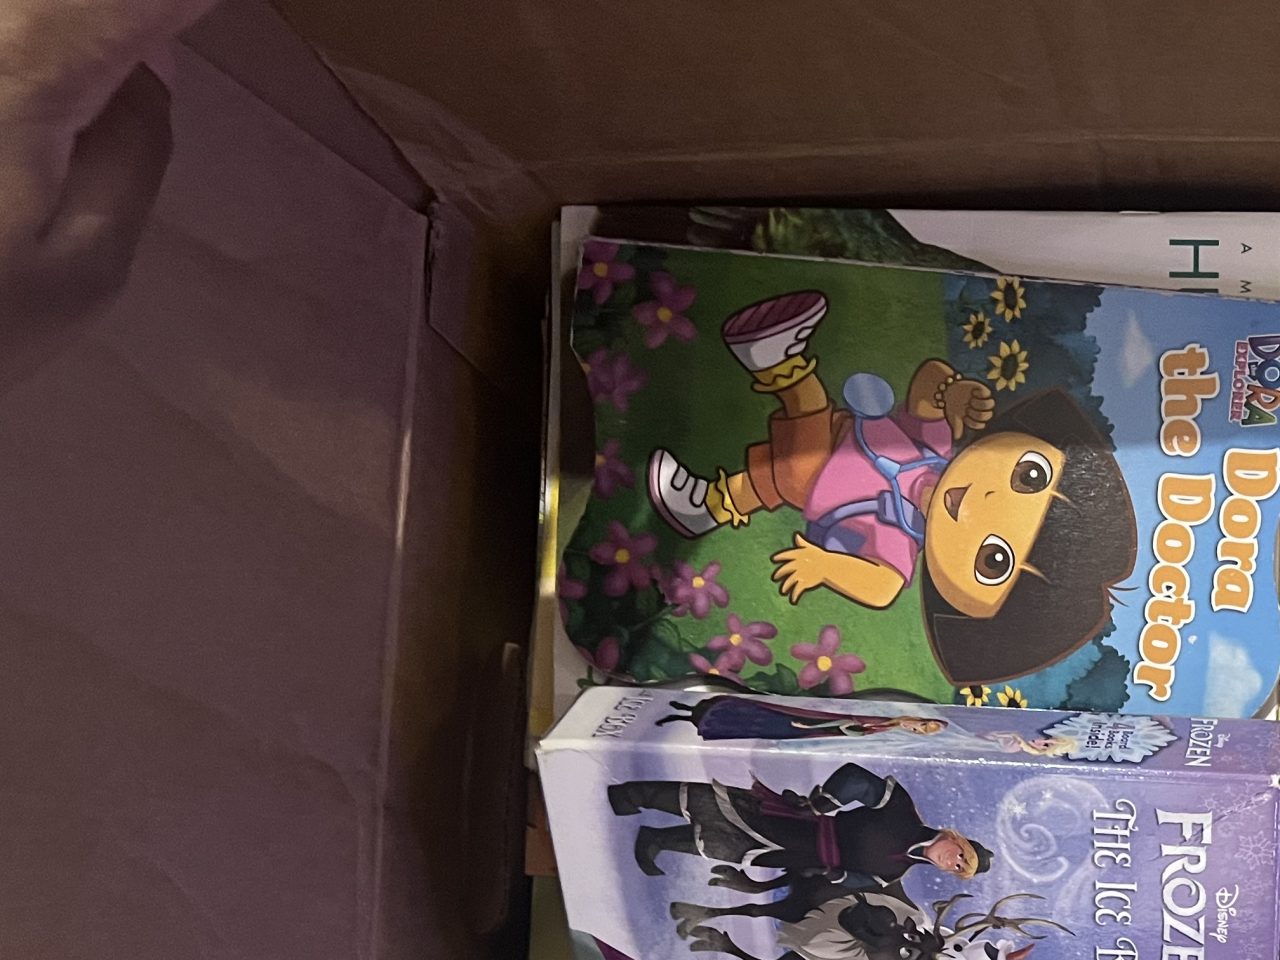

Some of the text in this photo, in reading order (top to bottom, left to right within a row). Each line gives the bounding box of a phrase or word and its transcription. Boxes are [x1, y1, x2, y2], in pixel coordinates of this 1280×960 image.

[1133, 343, 1219, 701] the Doctor
[1212, 447, 1280, 613] Dora
[1184, 717, 1218, 767] FROZEN
[1092, 798, 1138, 868] THE
[1094, 881, 1137, 926] ICE
